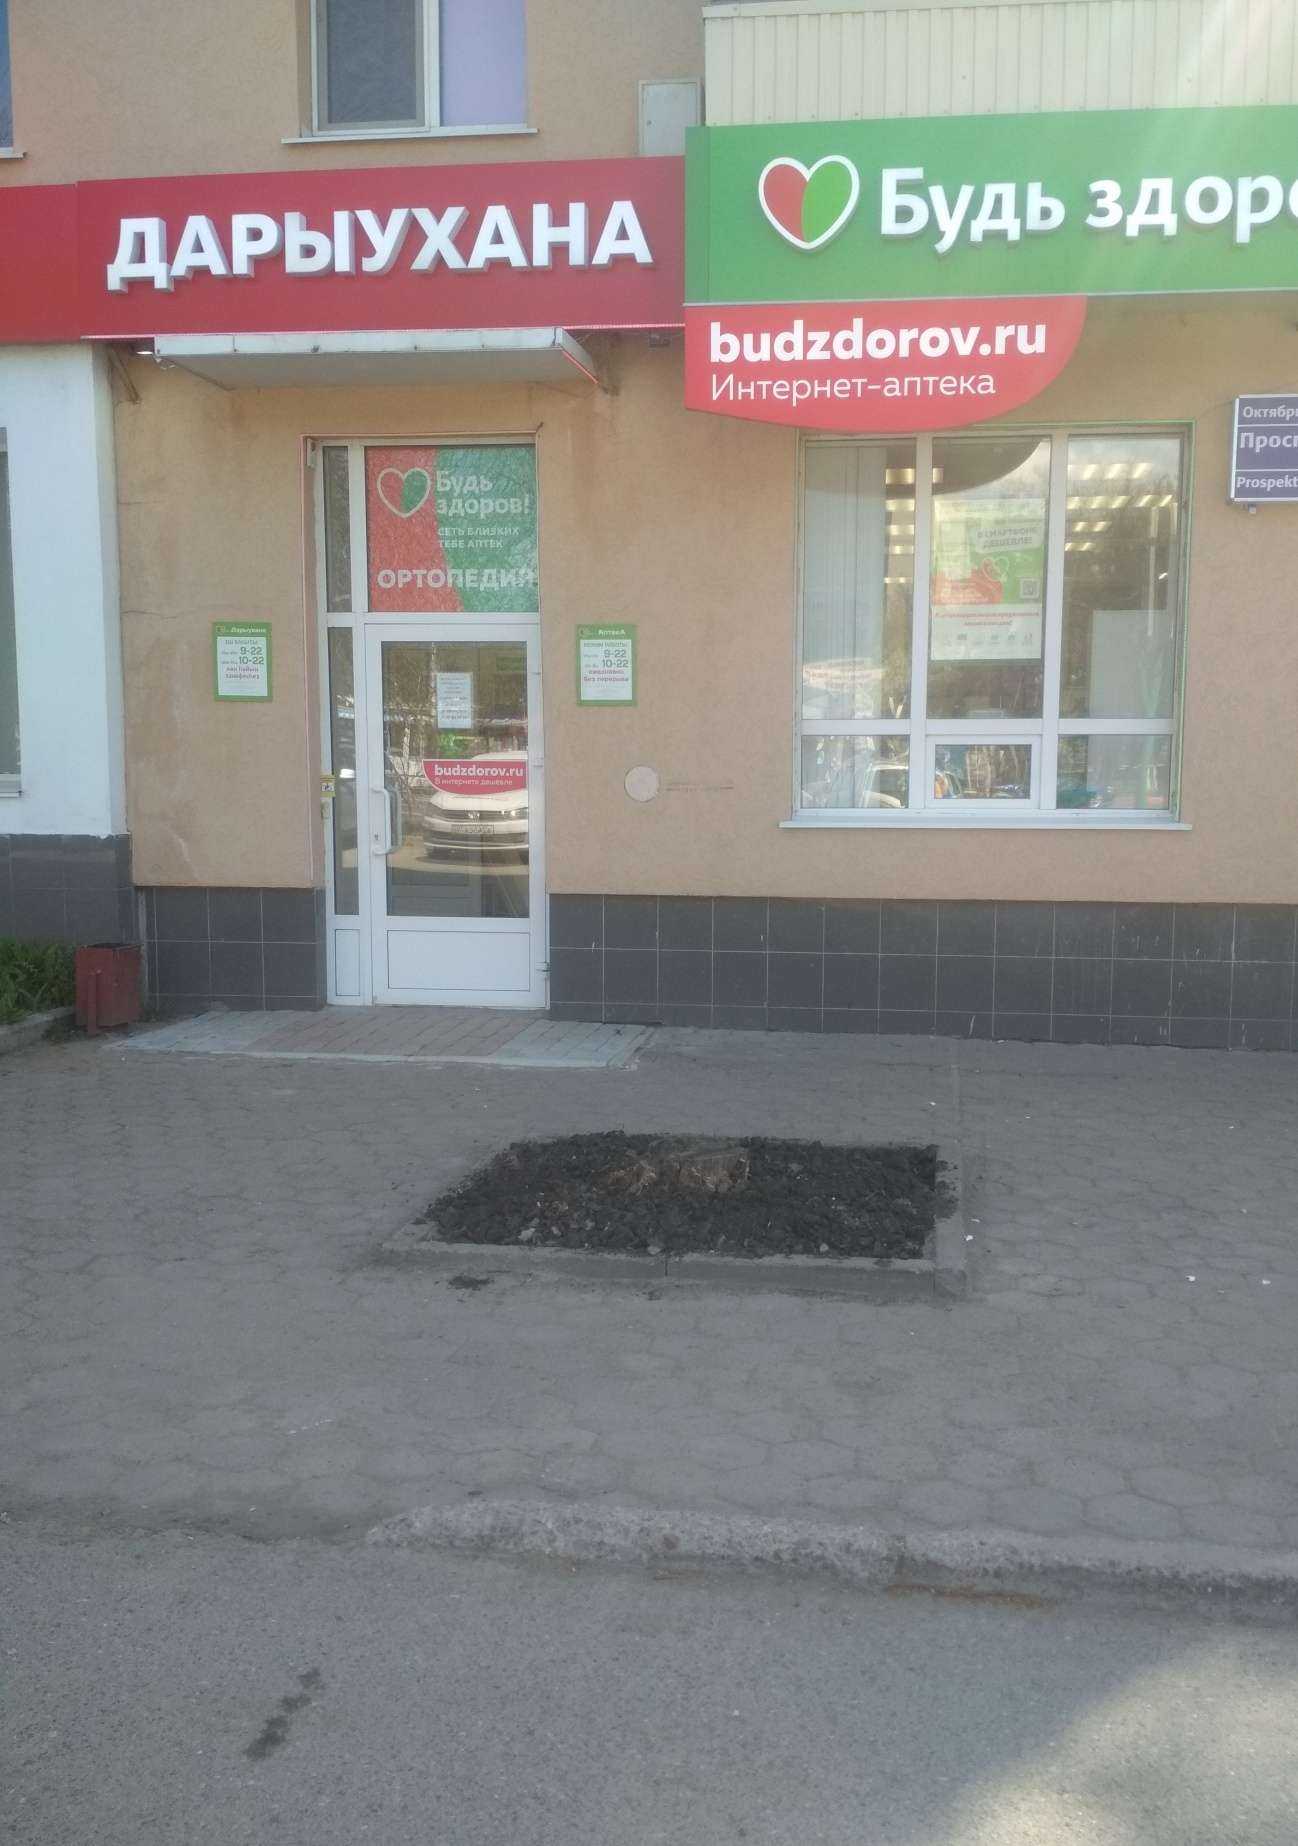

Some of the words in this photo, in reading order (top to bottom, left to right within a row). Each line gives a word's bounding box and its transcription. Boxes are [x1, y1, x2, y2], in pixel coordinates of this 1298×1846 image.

[880, 167, 1066, 255] Будь
[1085, 172, 1298, 244] здор
[107, 200, 654, 294] ДАРЫУХАНА
[709, 318, 1047, 363] budzdorov.ru
[711, 371, 996, 407] Интернет-аптека
[436, 471, 493, 497] Будь
[436, 496, 530, 519] здоров!
[438, 527, 465, 536] СЕТЬ
[467, 527, 520, 536] БЛИЗКИХ
[467, 539, 504, 549] АПТЕК
[376, 566, 536, 591] ОРТОПЕДИЯ
[240, 646, 263, 656] 9-22
[604, 649, 626, 659] 9-22
[239, 656, 265, 665] 10-22
[602, 659, 629, 668] 10-22
[434, 765, 524, 777] budzdorov.ru
